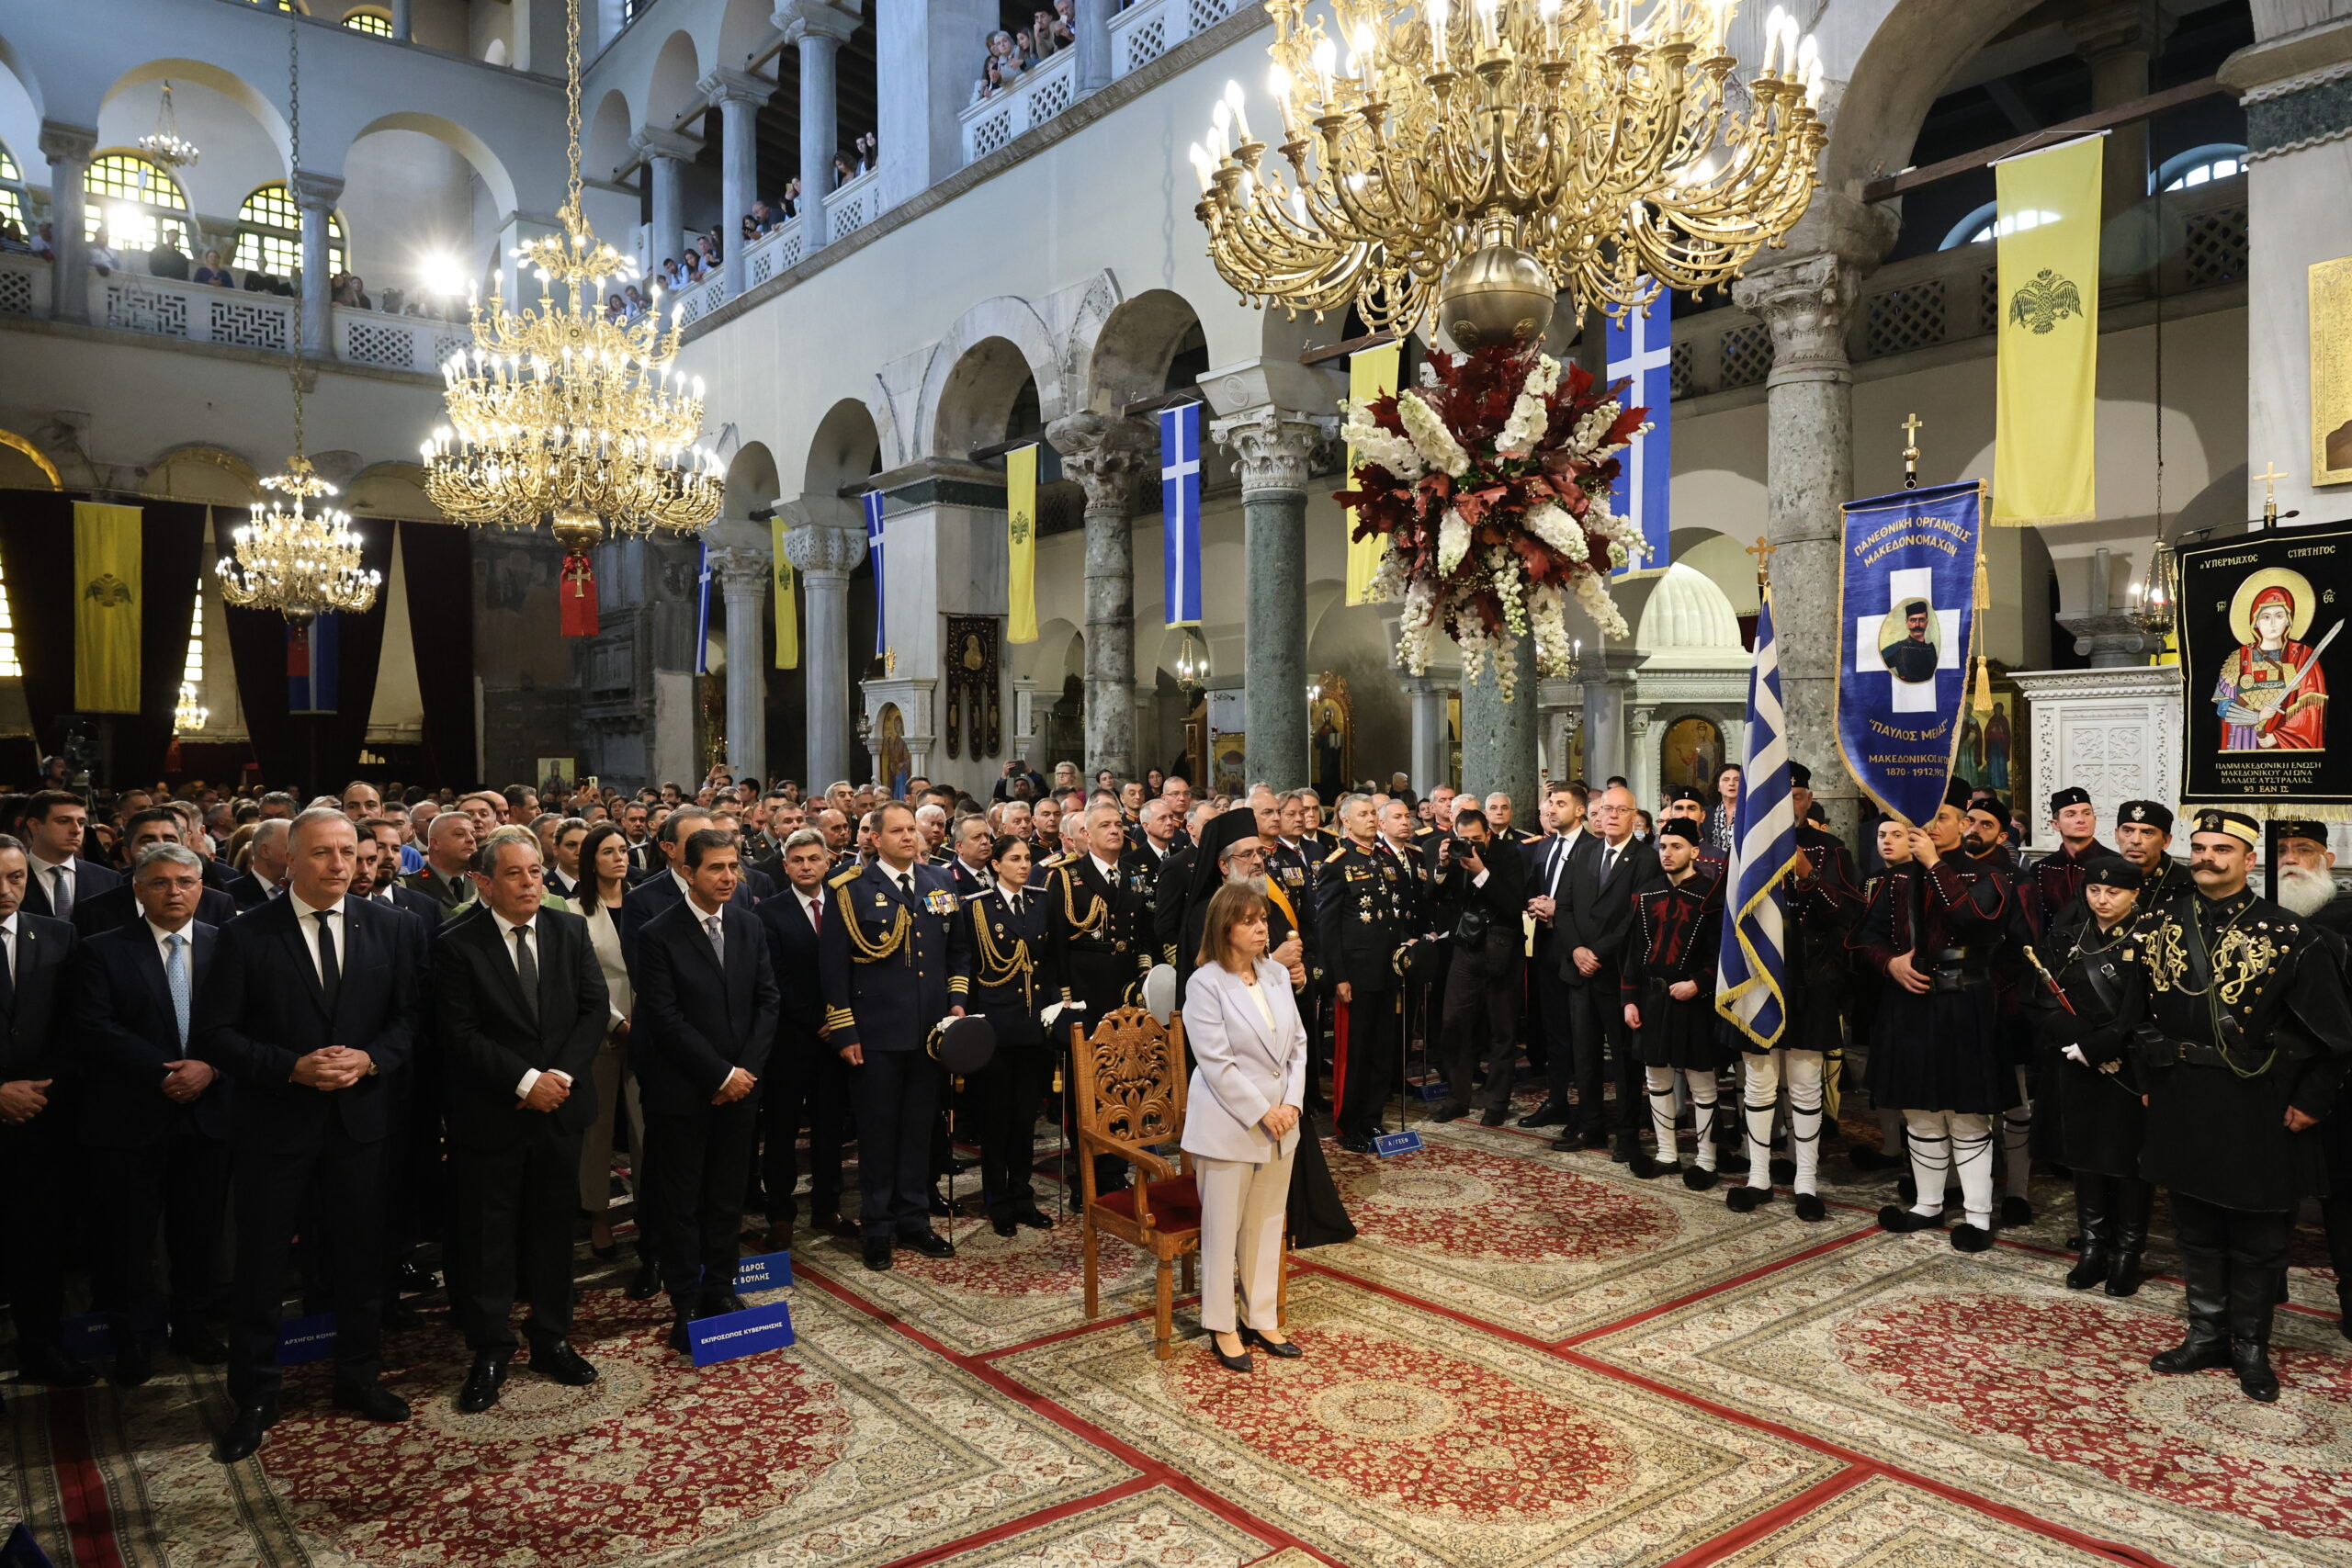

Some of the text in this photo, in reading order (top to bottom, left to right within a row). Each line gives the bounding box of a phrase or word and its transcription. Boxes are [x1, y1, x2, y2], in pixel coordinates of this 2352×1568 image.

[1854, 516, 1972, 557] ΠΑΝΕΘΝΙΚΗ ΟΡΓΑΝΩΣΙΣ
[1863, 535, 1958, 568] ΜΑΚΕΔΟΝΟΜΑΧΩΝ
[1885, 768, 1906, 776] 1870
[739, 1262, 765, 1273] ΕΔΡΟΣ
[741, 1272, 770, 1284] ΒΟΥΛΗΣ
[701, 1321, 783, 1345] ΕΚΠΡΟΣΩΠΟΣ ΚΥΒΕΡΝΗΣΗΣ
[284, 1336, 314, 1346] ΑΡΧΗΓΟΙ
